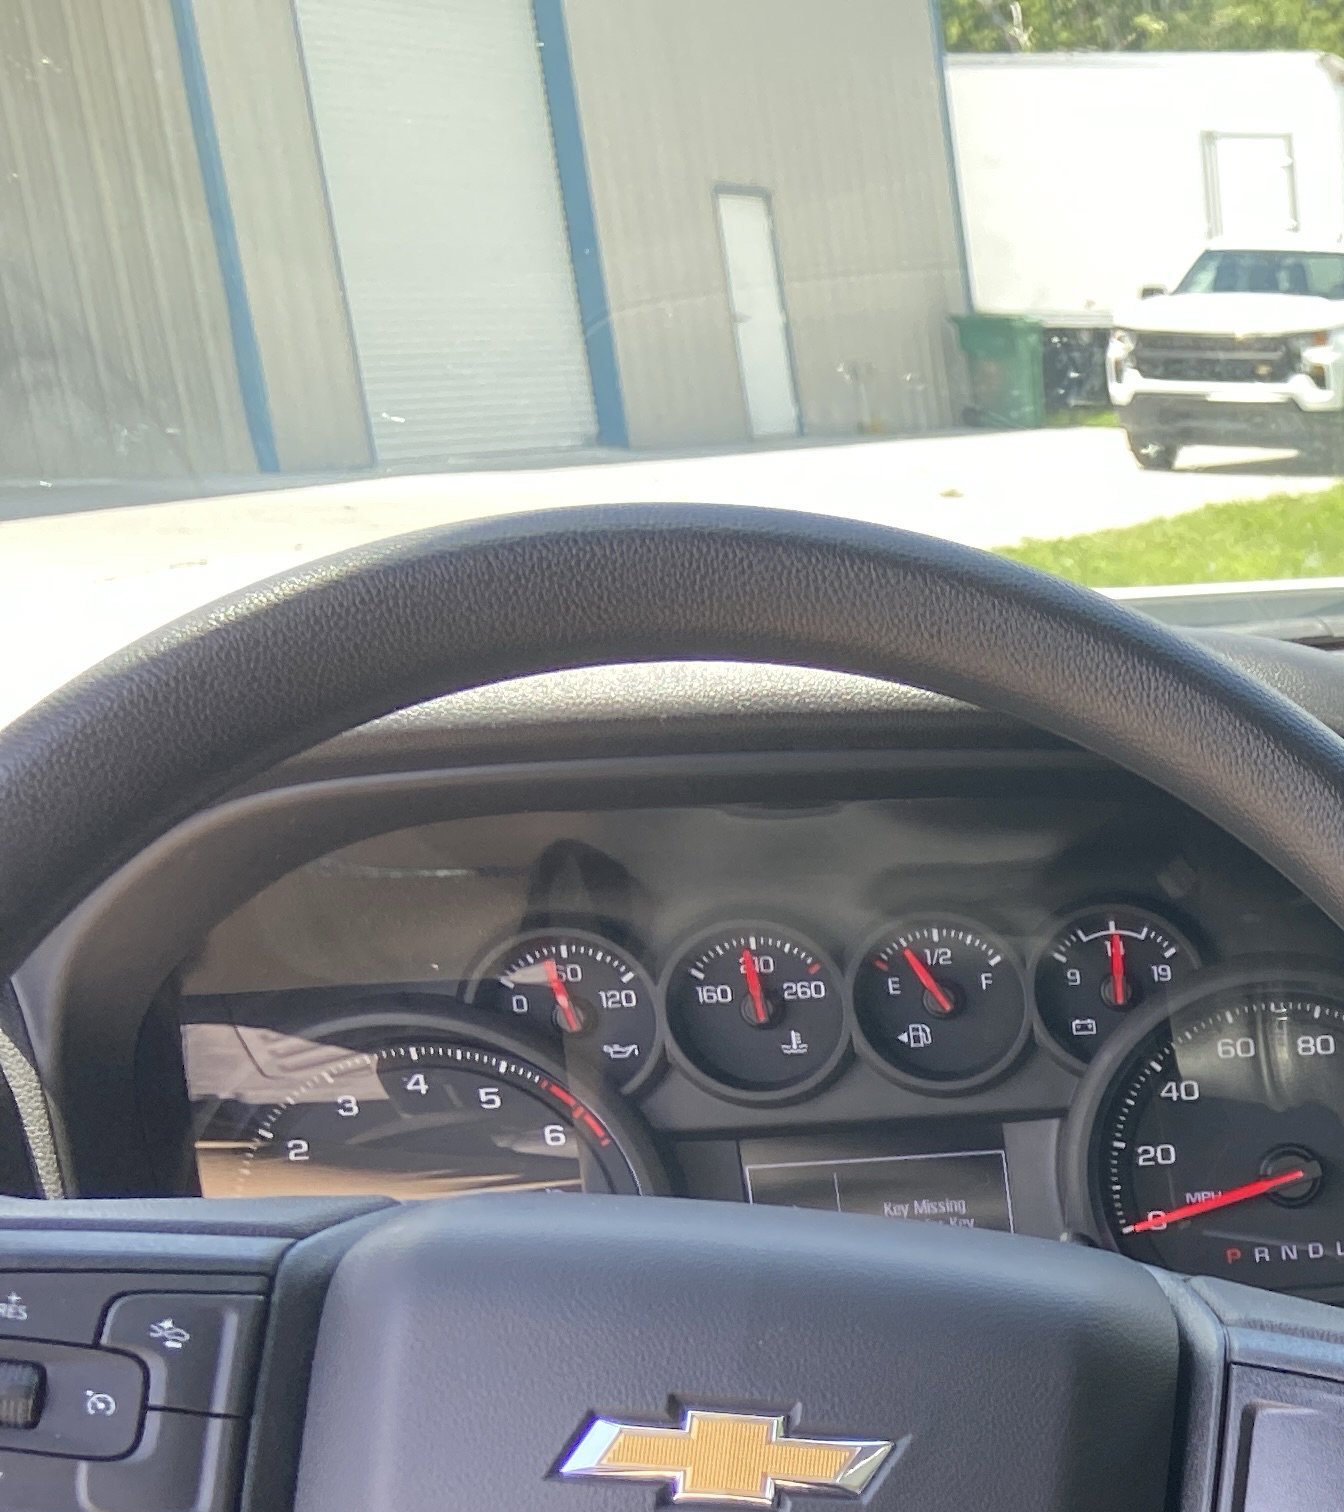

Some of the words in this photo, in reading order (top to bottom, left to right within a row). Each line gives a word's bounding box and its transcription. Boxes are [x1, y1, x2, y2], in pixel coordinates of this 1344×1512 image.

[924, 948, 952, 966] 1/2
[981, 973, 993, 991] F
[1067, 969, 1081, 986] 9
[1151, 964, 1172, 982] 19
[696, 985, 732, 1004] 160
[783, 981, 825, 1000] 260
[888, 977, 901, 995] E
[512, 994, 528, 1013] 0
[599, 990, 637, 1009] 120
[1217, 1037, 1256, 1058] 60
[1297, 1034, 1335, 1056] 80
[406, 1073, 429, 1095] 4
[1160, 1080, 1199, 1101] 40
[337, 1095, 360, 1118] 3
[478, 1087, 502, 1110] 5
[544, 1124, 566, 1146] 6
[286, 1139, 309, 1162] 2
[1137, 1143, 1176, 1166] 20
[883, 1201, 909, 1219] Key
[913, 1198, 966, 1215] Missing
[1226, 1248, 1241, 1264] P
[1254, 1247, 1270, 1263] R
[1281, 1244, 1298, 1261] N
[1308, 1242, 1324, 1259] D
